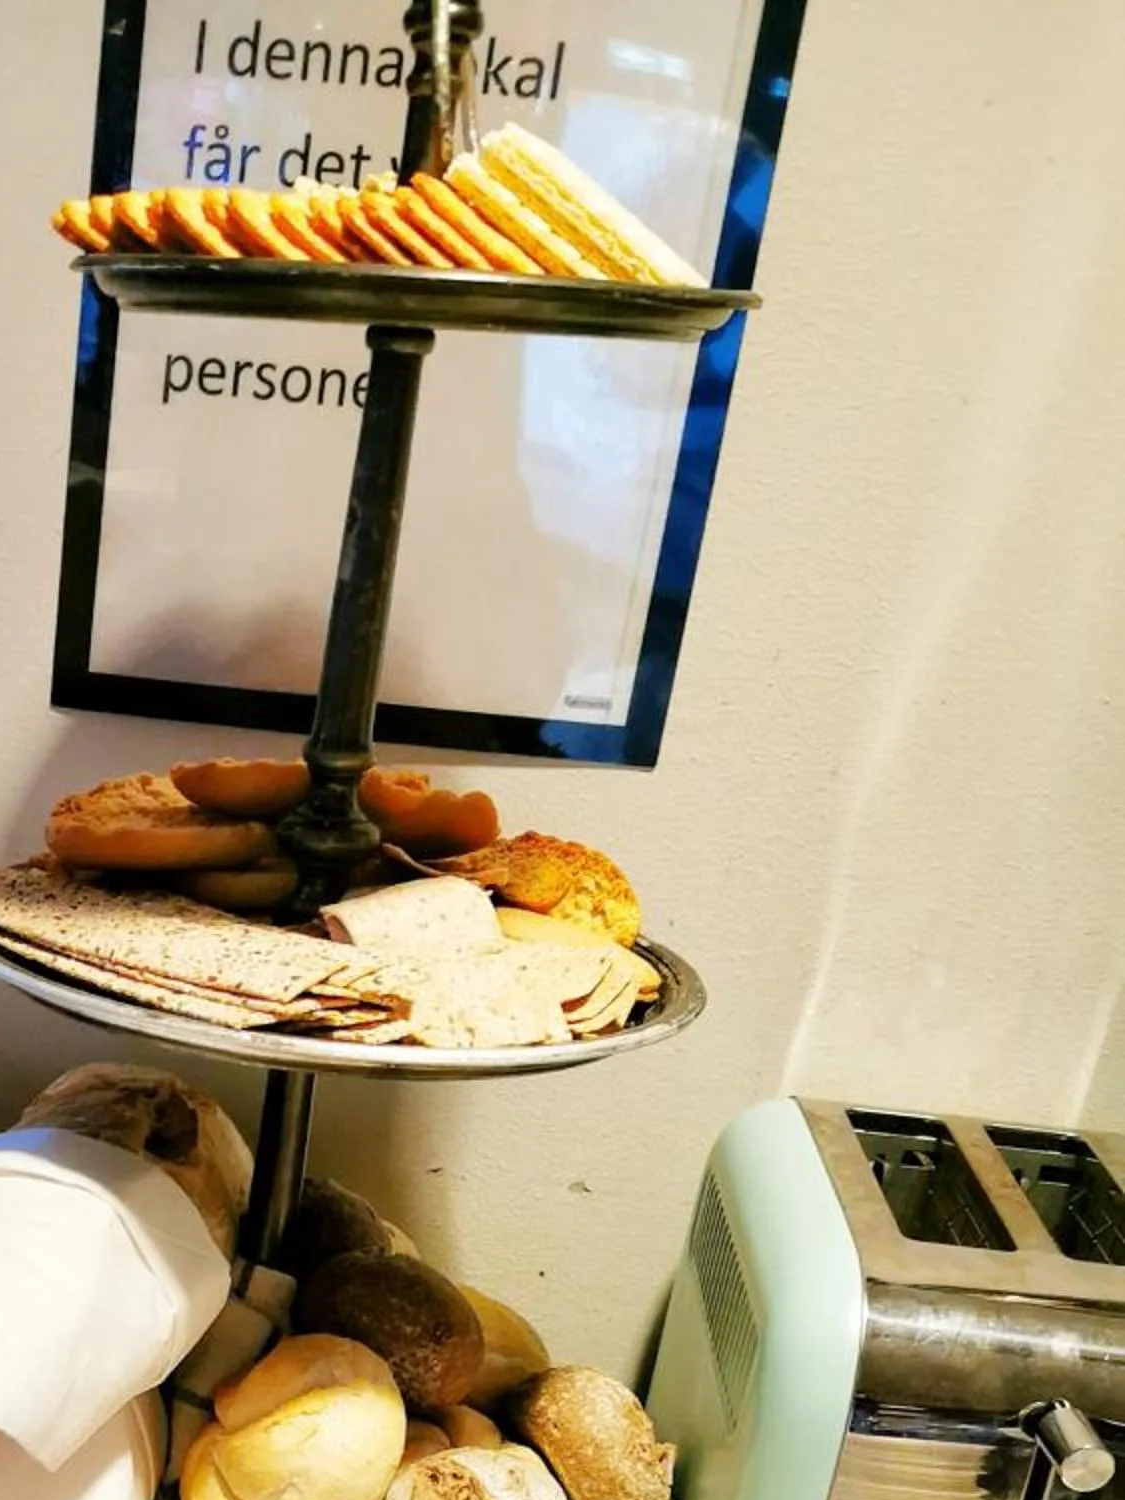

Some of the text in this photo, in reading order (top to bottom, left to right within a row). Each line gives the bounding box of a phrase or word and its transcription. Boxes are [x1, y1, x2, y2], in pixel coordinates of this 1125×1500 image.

[194, 19, 567, 101] I denna kal
[182, 124, 373, 190] får det
[162, 353, 371, 408] persone
